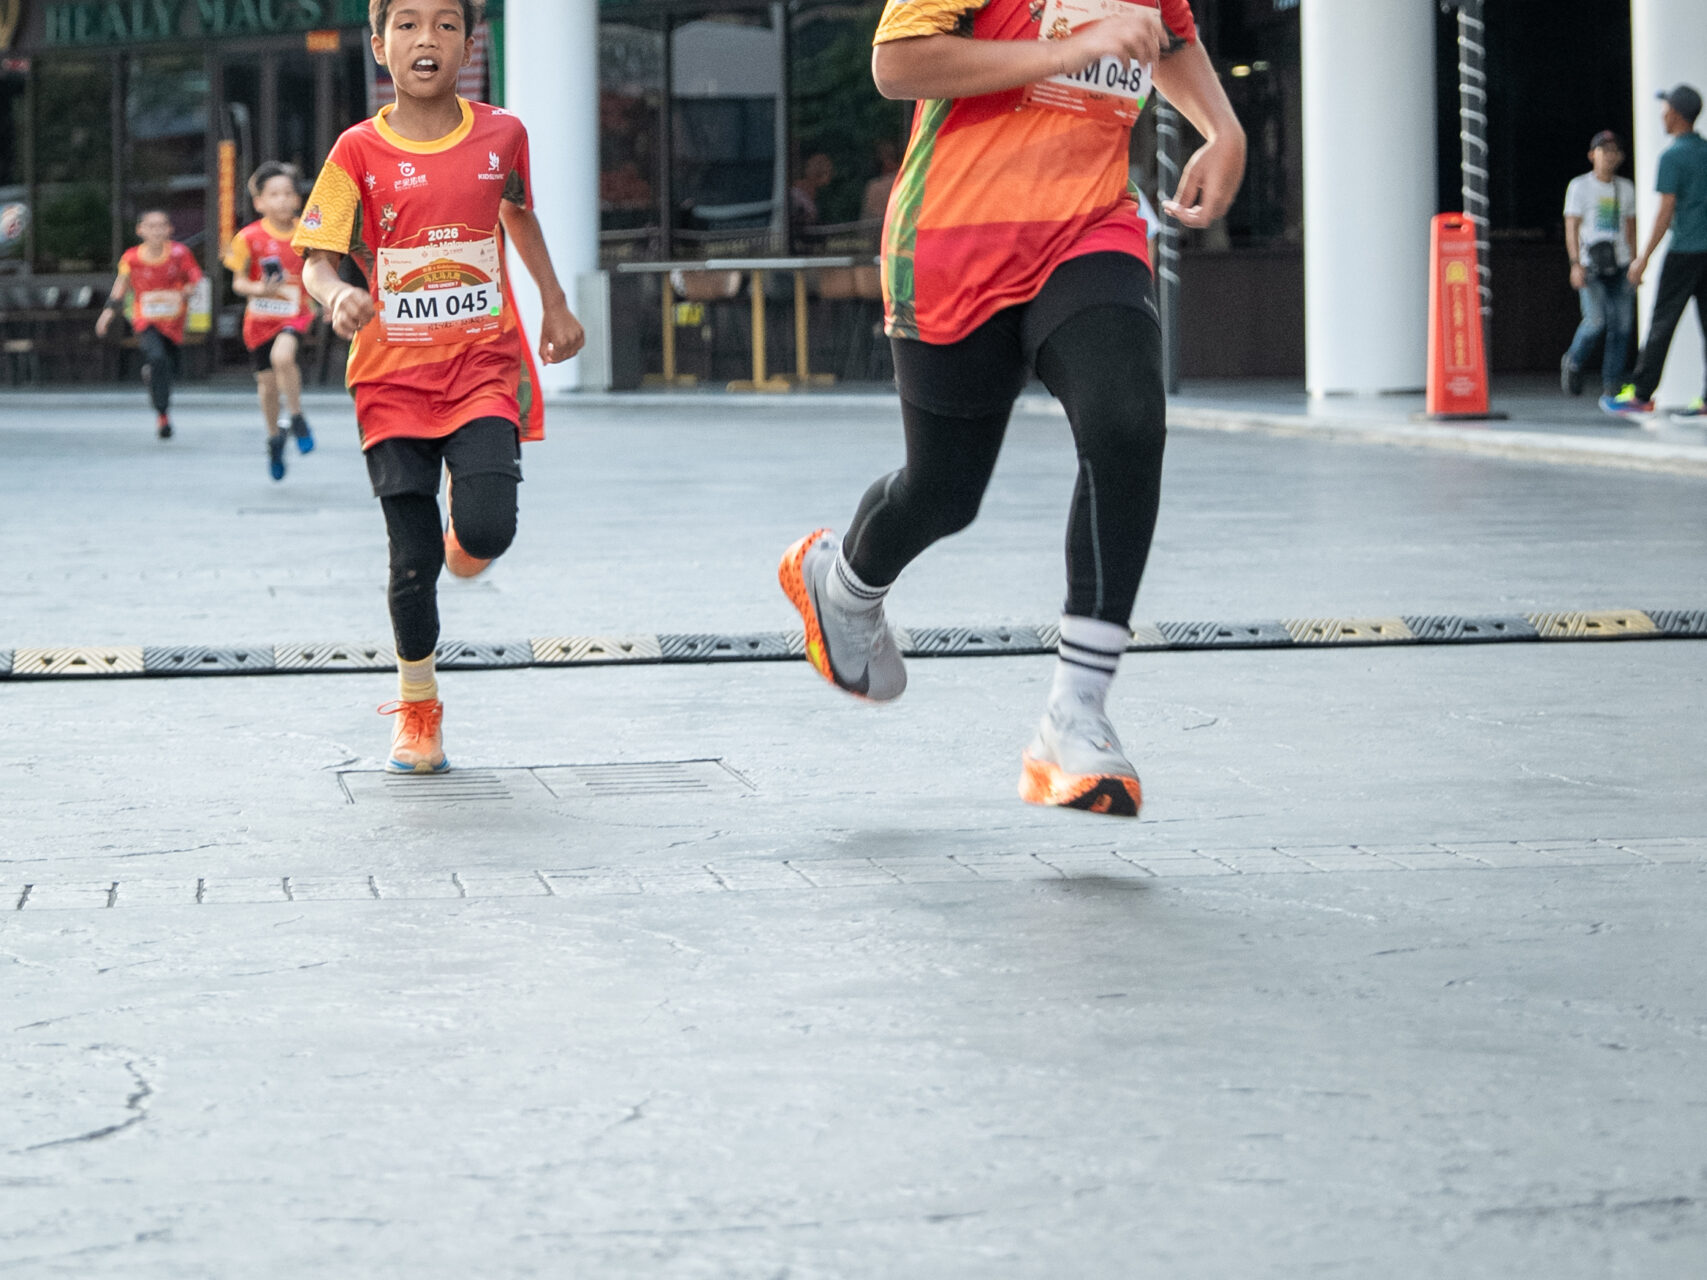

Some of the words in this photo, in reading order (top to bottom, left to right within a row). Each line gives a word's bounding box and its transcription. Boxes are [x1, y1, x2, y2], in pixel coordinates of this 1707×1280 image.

[1065, 58, 1101, 85] M
[1106, 62, 1142, 92] 048
[428, 227, 459, 242] 2026
[396, 296, 439, 319] AM
[446, 289, 488, 316] 045
